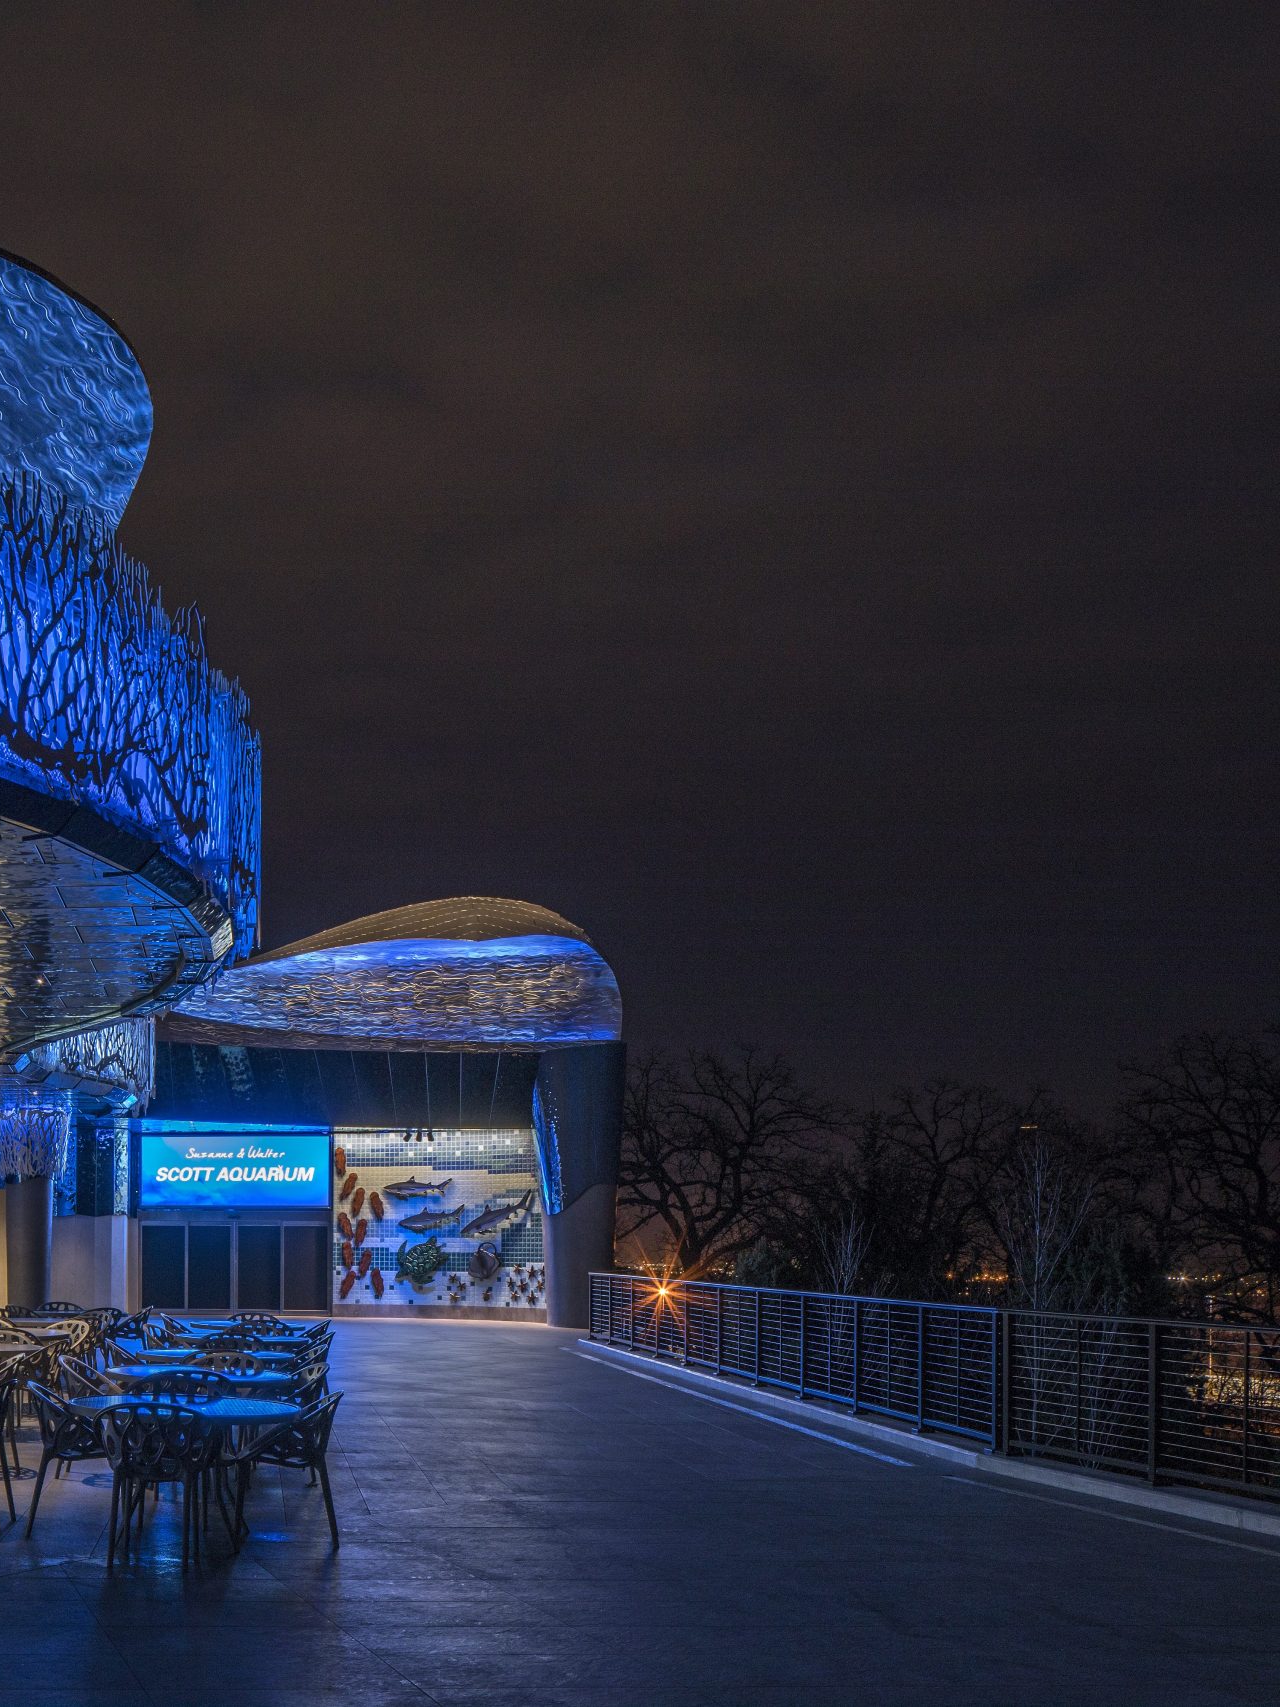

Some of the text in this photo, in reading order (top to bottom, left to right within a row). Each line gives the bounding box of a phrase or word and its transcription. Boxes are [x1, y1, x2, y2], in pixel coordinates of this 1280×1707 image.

[185, 1145, 286, 1159] Suzanne & Walter
[155, 1165, 315, 1182] SCOTT AQUARIUM
